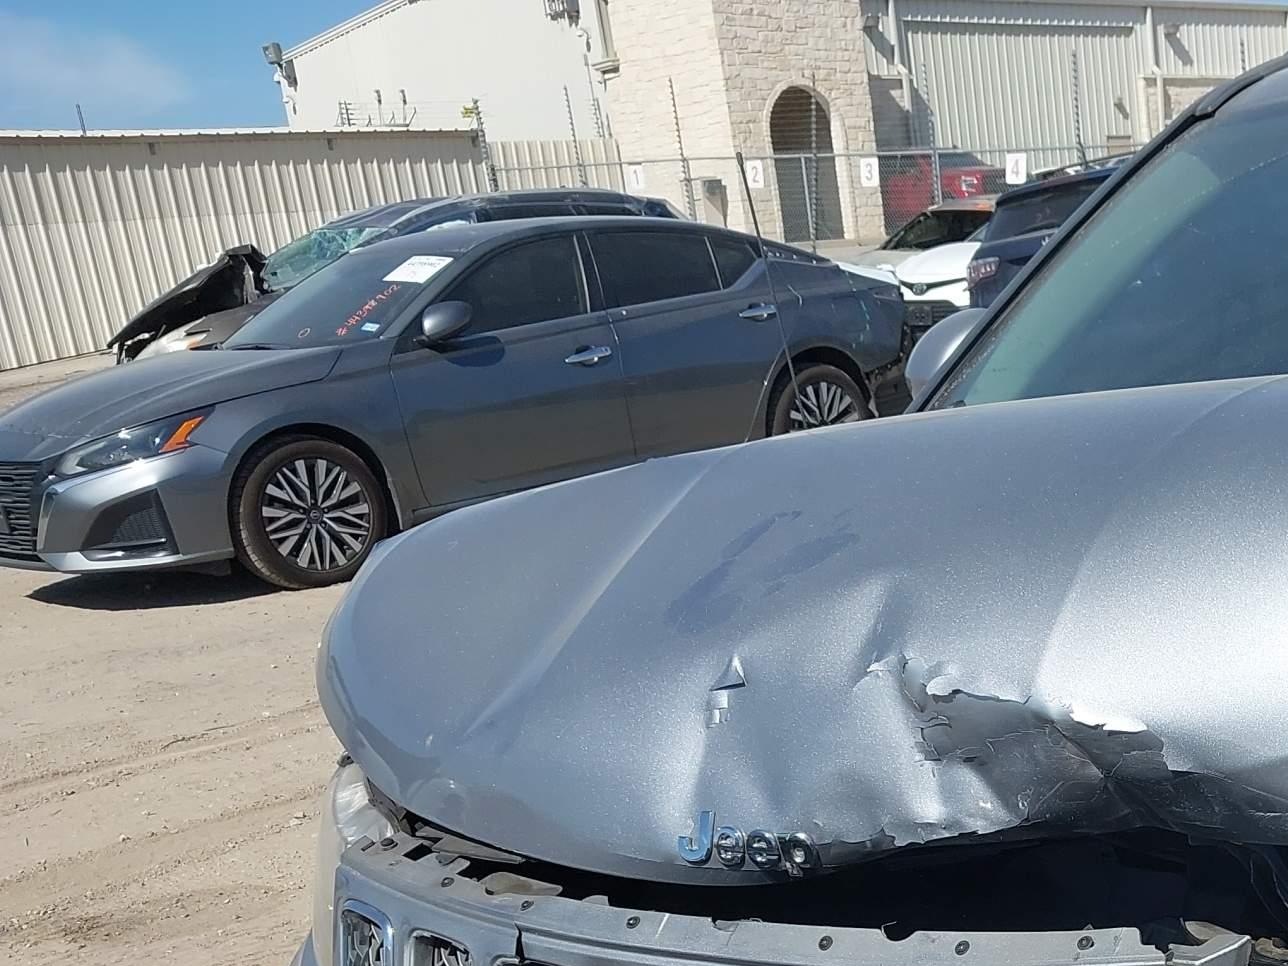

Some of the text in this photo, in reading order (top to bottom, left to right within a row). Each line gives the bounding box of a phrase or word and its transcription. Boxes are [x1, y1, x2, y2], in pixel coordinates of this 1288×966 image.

[751, 167, 760, 183] 2
[865, 163, 873, 181] 3
[1011, 159, 1020, 178] 4
[678, 810, 822, 877] Jeep
